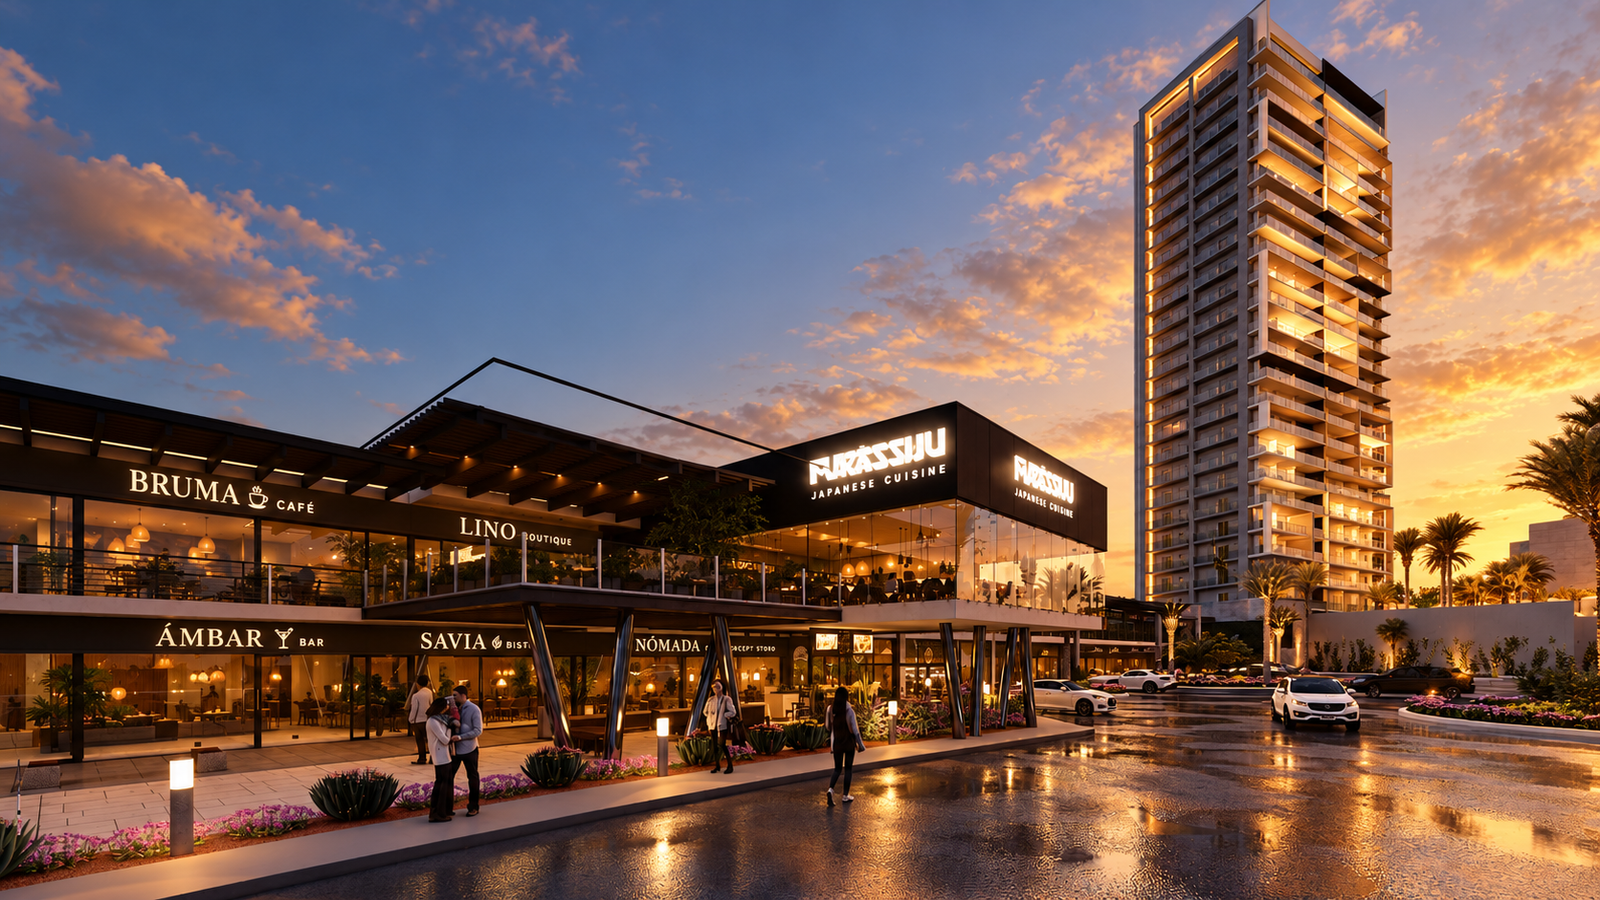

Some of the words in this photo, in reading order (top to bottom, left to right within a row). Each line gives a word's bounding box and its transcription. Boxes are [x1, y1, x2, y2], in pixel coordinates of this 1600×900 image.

[129, 468, 240, 506] BRUMA
[276, 499, 315, 514] CAFÉ
[810, 479, 875, 500] JAPANESE
[884, 464, 946, 485] CUISINE
[460, 516, 516, 541] LINO
[155, 622, 264, 648] ÁMBAR
[299, 638, 324, 647] BAR
[420, 632, 487, 650] SAVIA
[635, 635, 700, 652] NÓMADA
